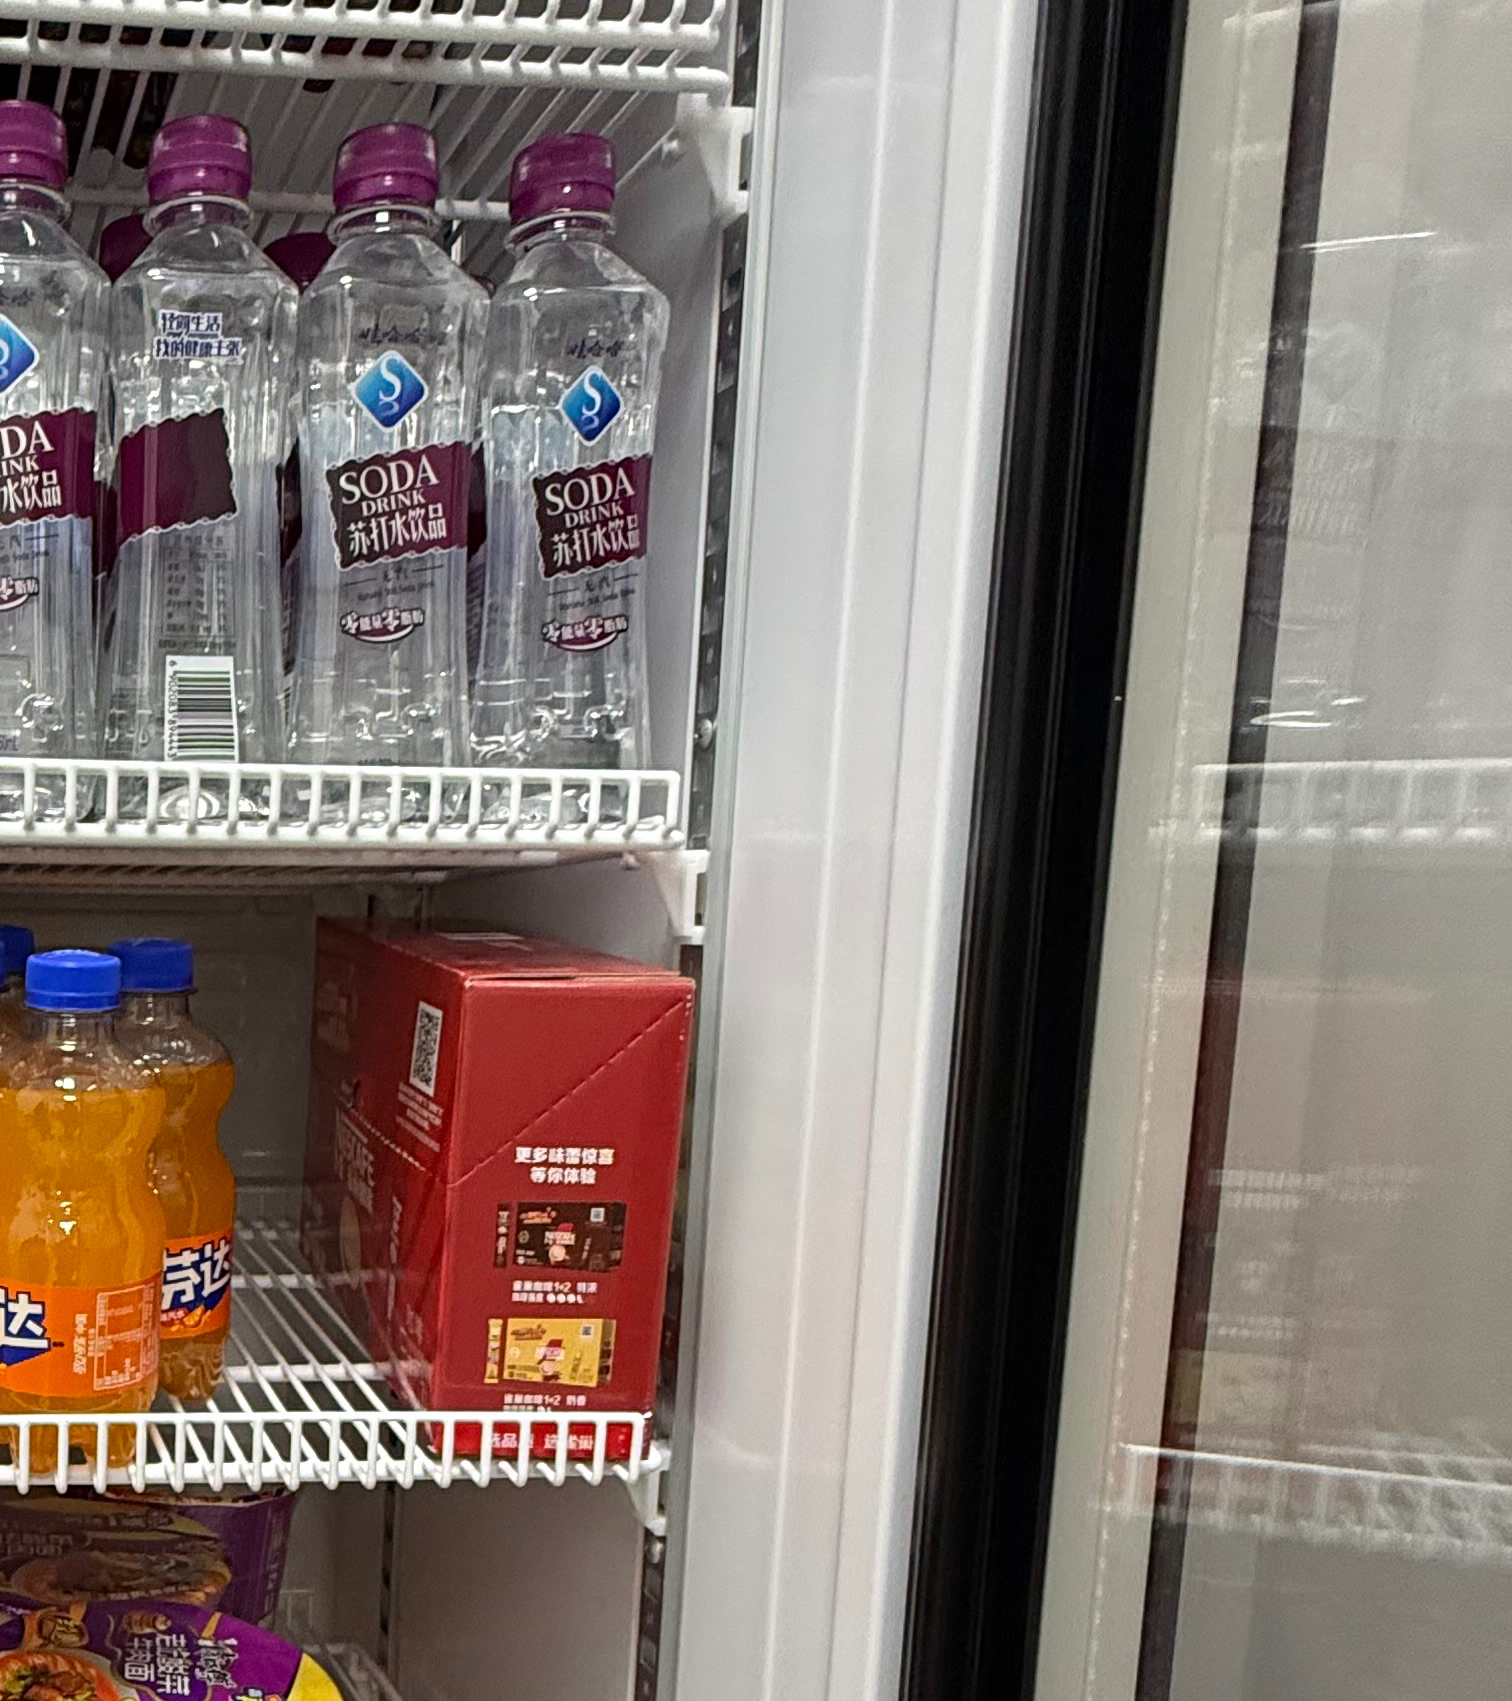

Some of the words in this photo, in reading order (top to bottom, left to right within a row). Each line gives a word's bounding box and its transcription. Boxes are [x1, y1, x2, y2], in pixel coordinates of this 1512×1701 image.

[338, 455, 439, 505] SODA
[361, 488, 426, 517] DRINK
[544, 467, 636, 516] SODA
[347, 503, 447, 556] 苏打水饮品
[564, 501, 624, 529] DRINK
[550, 514, 640, 567] 苏打水饮品
[529, 1167, 597, 1184] 等你体验
[161, 1239, 230, 1310] 芬达
[123, 1637, 156, 1682] 牛肉面
